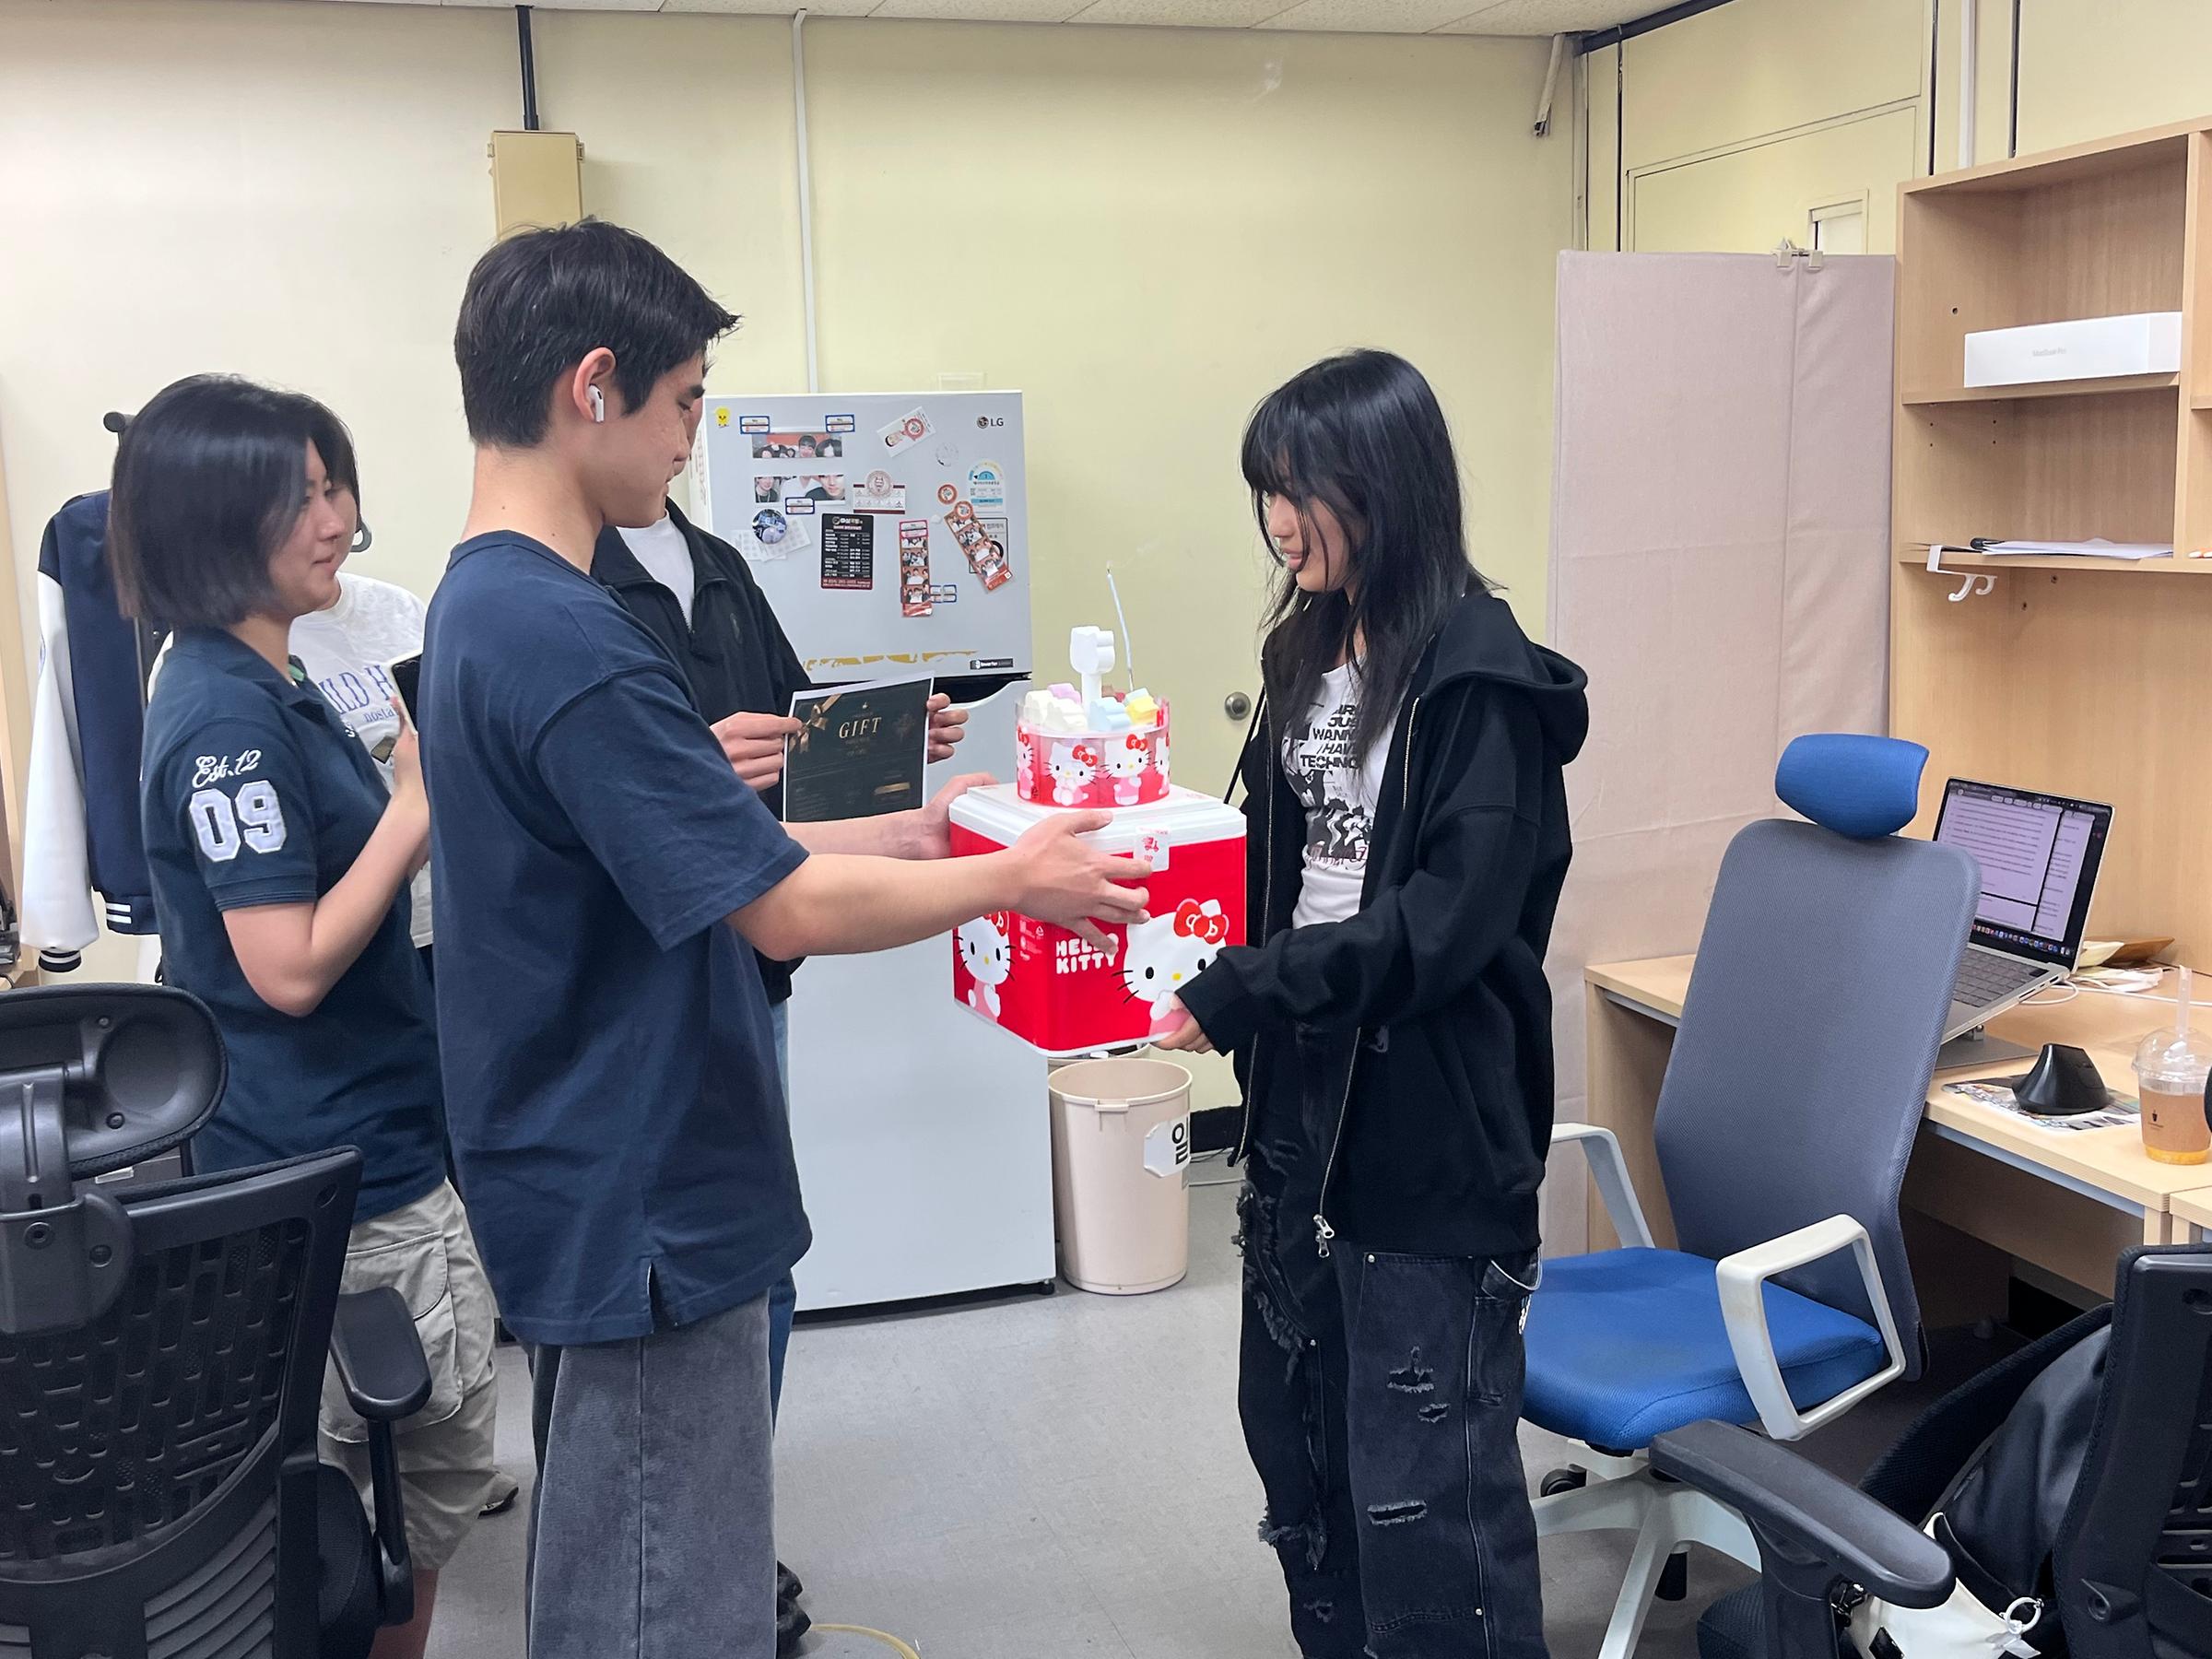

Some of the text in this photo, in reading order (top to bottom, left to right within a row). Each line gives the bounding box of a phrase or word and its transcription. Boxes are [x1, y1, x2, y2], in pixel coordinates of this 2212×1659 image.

[991, 418, 1004, 427] LG
[839, 716, 882, 738] GIFT
[189, 780, 287, 862] 09
